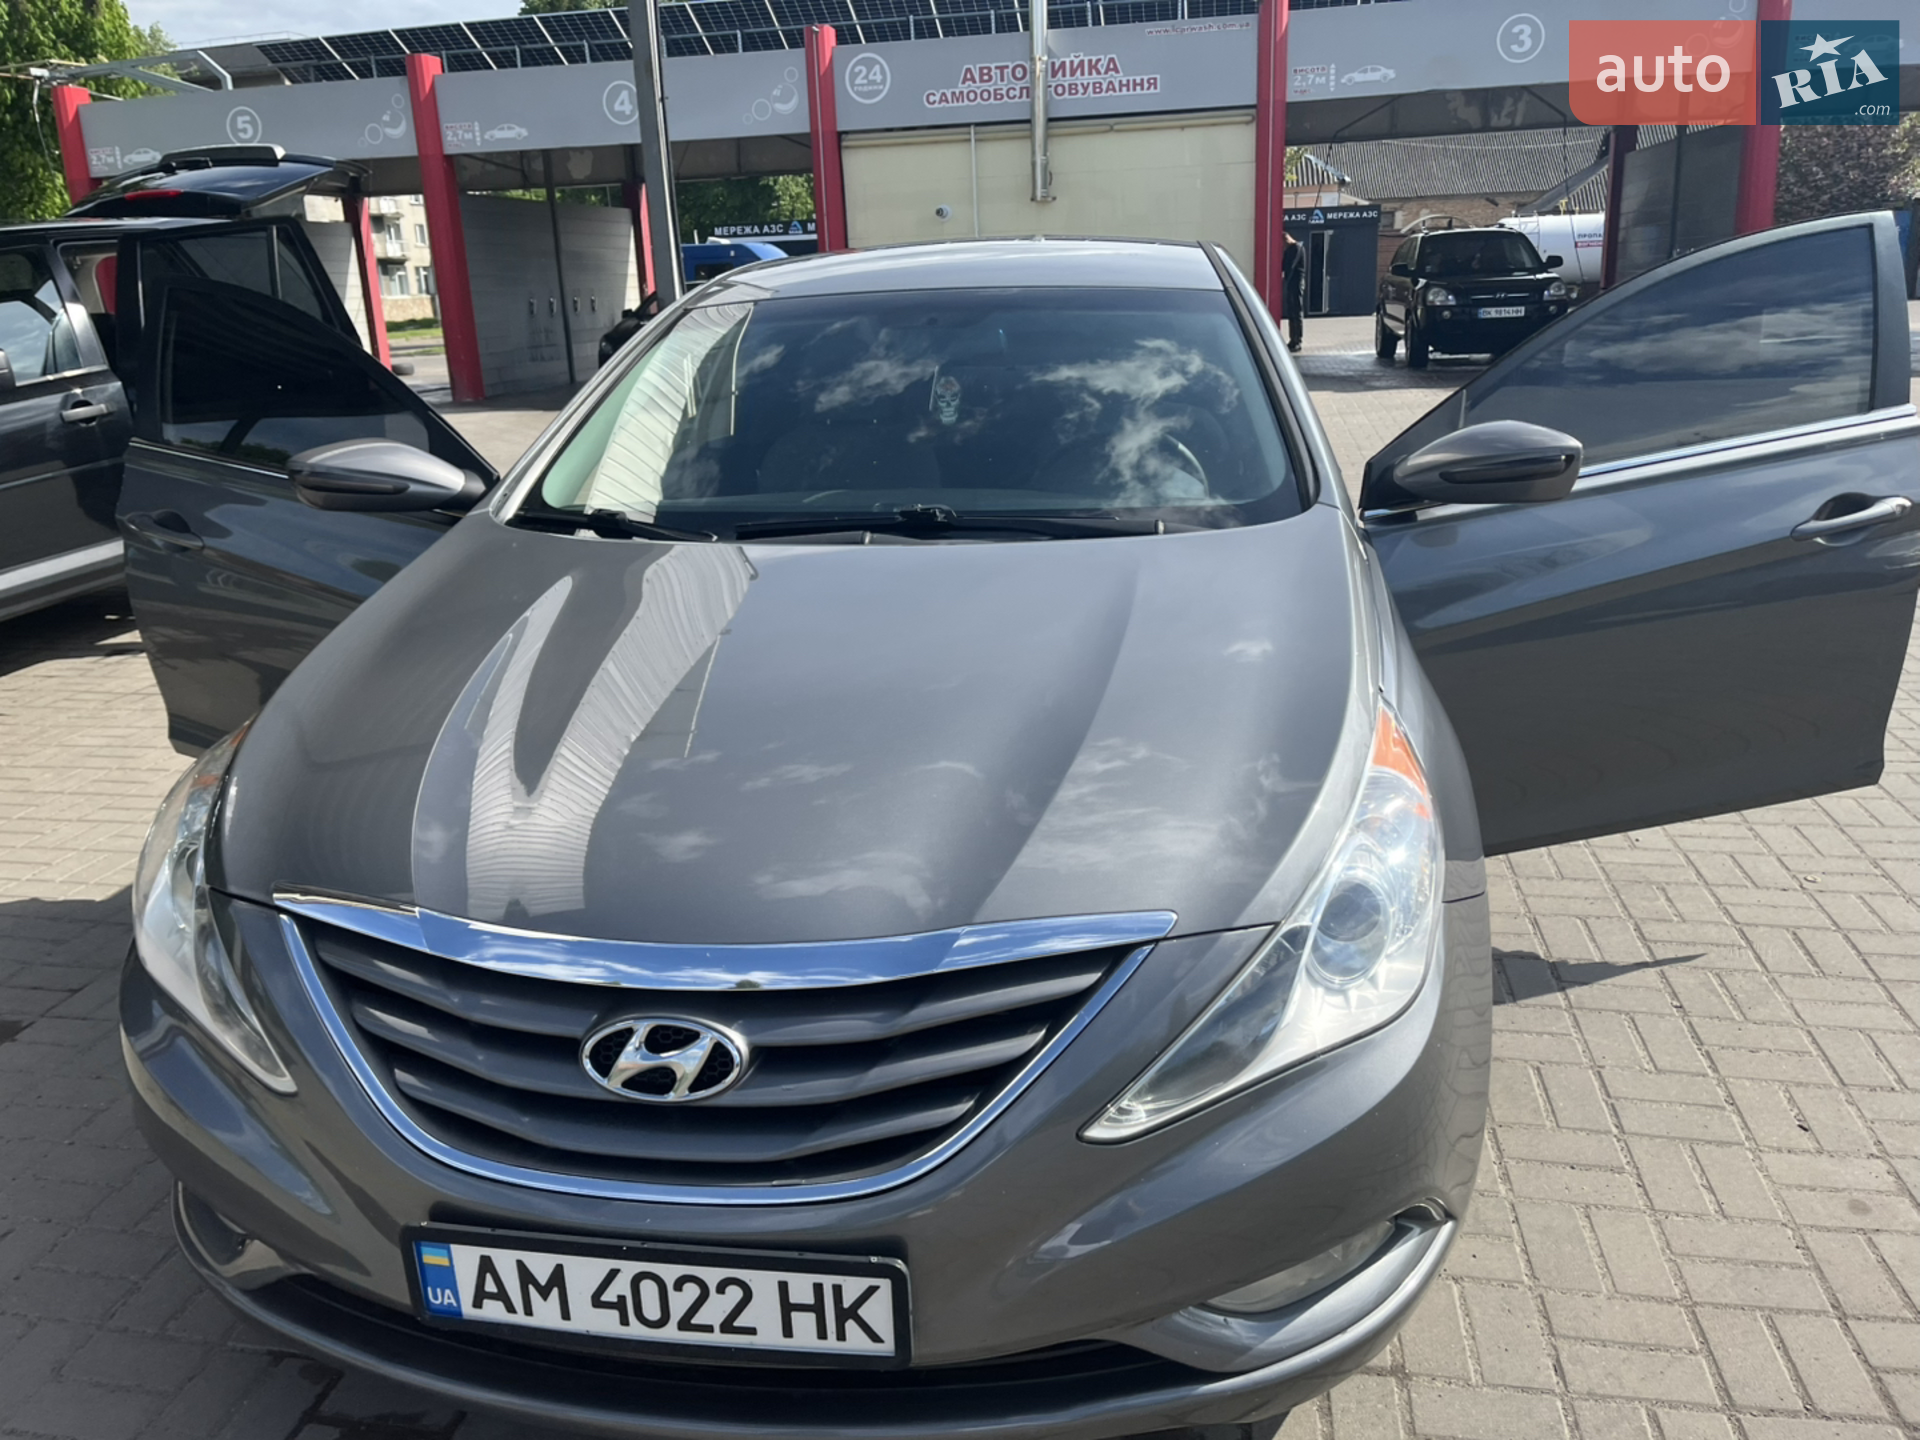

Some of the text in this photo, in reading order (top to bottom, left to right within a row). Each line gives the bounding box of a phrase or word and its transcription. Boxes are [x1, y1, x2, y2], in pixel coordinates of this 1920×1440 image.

[1510, 24, 1532, 53] 3
[853, 64, 883, 85] 24
[960, 54, 1121, 86] АВТОИЙКА
[614, 90, 633, 115] 4
[925, 76, 1159, 106] САМООБСЛОВУВАННЯ
[236, 115, 253, 139] 5
[1290, 213, 1307, 221] АЗС
[1326, 210, 1378, 220] МЕРЕЖА АЗС
[714, 224, 760, 236] МЕРЕЖА
[762, 223, 784, 234] АЗС
[427, 1286, 457, 1308] UA
[471, 1254, 885, 1345] AM 4022 HK
